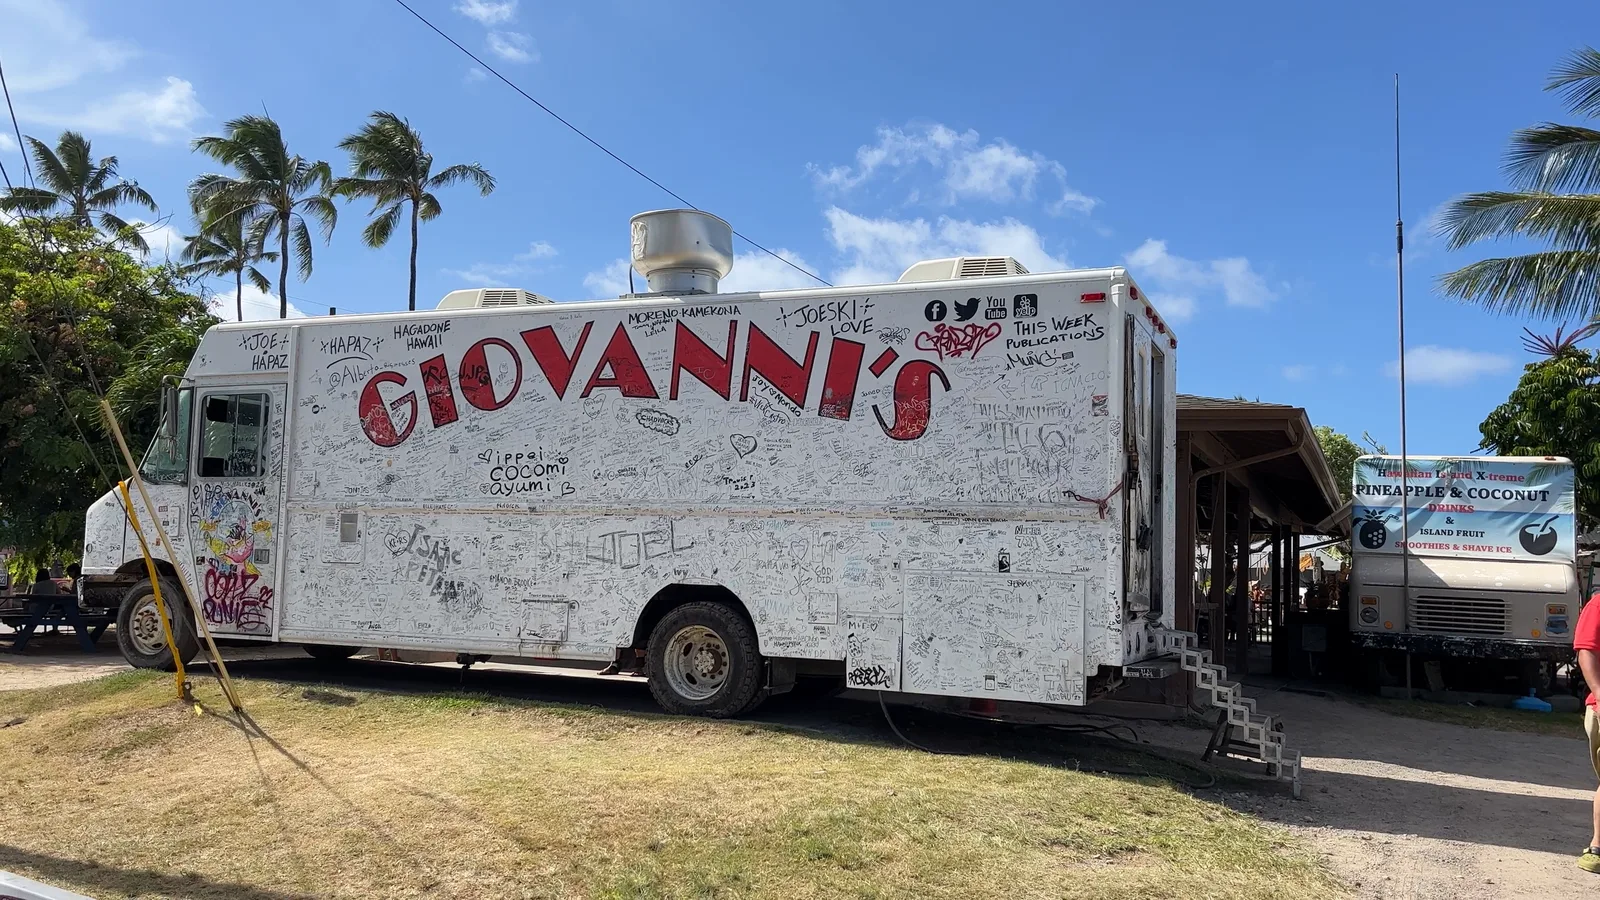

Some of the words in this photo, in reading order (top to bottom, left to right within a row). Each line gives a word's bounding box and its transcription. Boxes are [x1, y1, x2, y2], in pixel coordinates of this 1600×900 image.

[986, 296, 1005, 307] You
[794, 300, 856, 327] JOESKI
[986, 309, 1006, 319] Tube
[1015, 306, 1036, 317] yelp
[393, 320, 451, 340] HAGADONE
[830, 317, 873, 336] LOVE
[1014, 320, 1047, 336] THIS
[1052, 313, 1097, 331] WEEK
[250, 333, 278, 350] JOE
[407, 334, 442, 351] HAWAII
[1006, 326, 1104, 349] PUBLICATIONS
[329, 336, 373, 358] HAPAZ
[252, 354, 288, 371] HAPAZ
[359, 319, 952, 447] GIOVANNI'S
[752, 375, 770, 392] JOY
[775, 394, 801, 417] Mondo
[496, 446, 543, 465] ippei
[1476, 471, 1525, 482] X-treme
[490, 477, 551, 496] ayumi
[1356, 484, 1445, 498] PINEAPPLE
[1450, 486, 1463, 498] &
[1467, 487, 1549, 502] COCONUT
[1428, 503, 1475, 514] DRINKS
[1445, 516, 1454, 525] &
[1420, 528, 1453, 537] ISLAND
[1456, 530, 1485, 538] FRUIT
[1462, 544, 1493, 553] SHAVE
[1496, 545, 1512, 553] ICE
